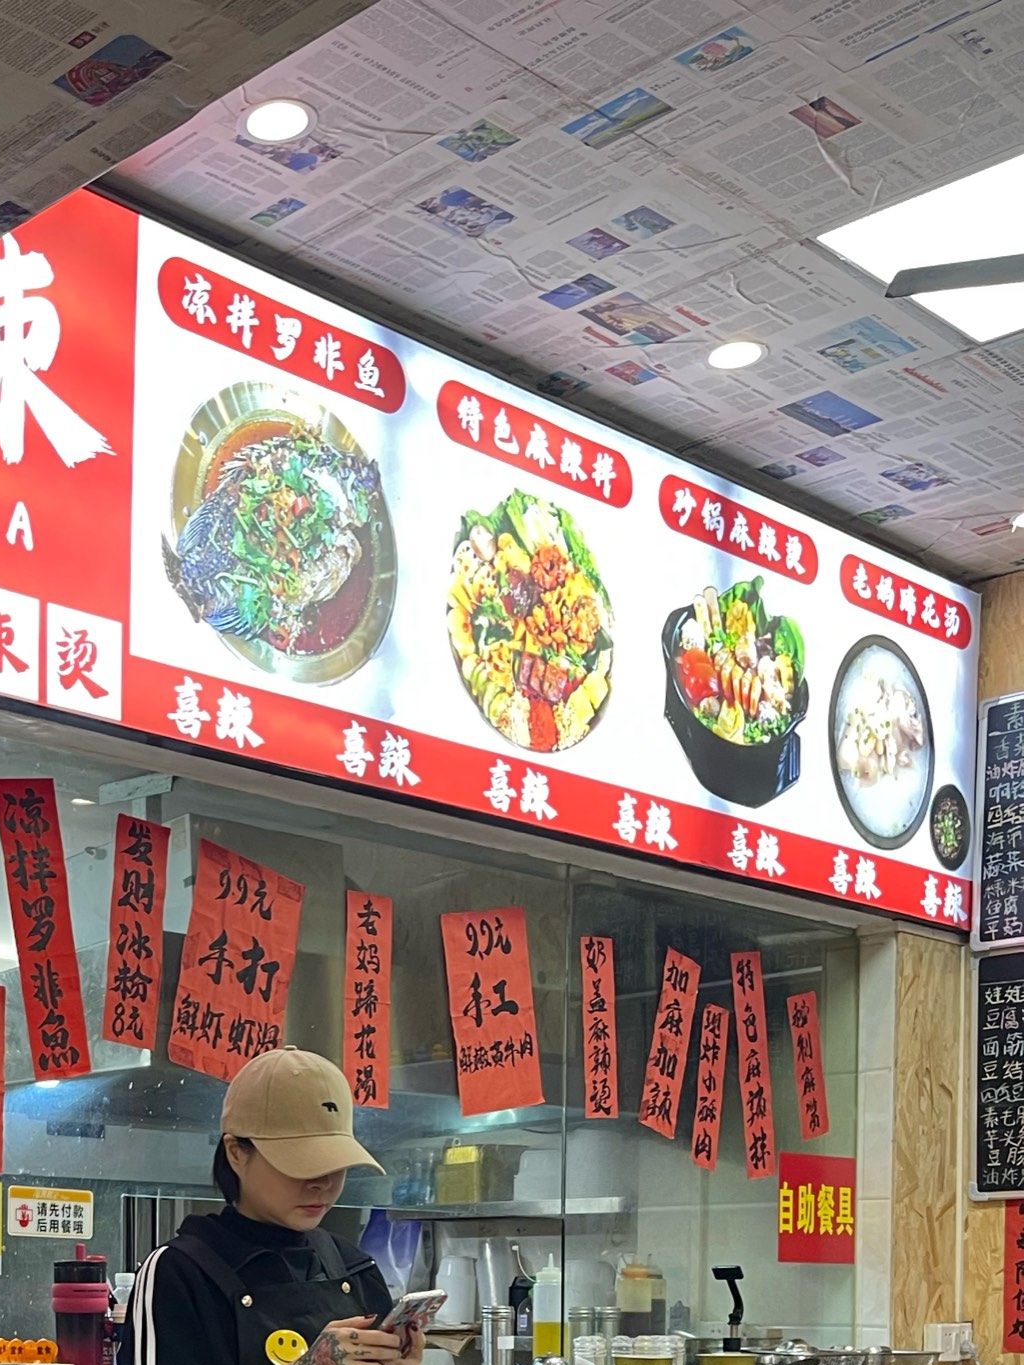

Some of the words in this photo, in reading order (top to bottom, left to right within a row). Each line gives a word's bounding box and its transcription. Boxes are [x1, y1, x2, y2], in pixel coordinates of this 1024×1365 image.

[182, 273, 385, 398] 凉拌罗非鱼
[457, 395, 617, 498] 特色麻辣拌
[672, 487, 807, 576] 砂锅麻辣烫
[167, 675, 265, 749] 喜辣
[336, 719, 421, 786] 喜辣
[483, 758, 558, 821] 喜辣
[612, 792, 679, 851] 喜辣
[727, 823, 785, 878] 喜辣
[828, 849, 882, 900] 喜辣
[920, 874, 968, 924] 喜辣
[198, 929, 280, 1002] 手打
[985, 986, 1024, 1005] 娃娃
[36, 1219, 84, 1235] 后用餐哦
[37, 1202, 84, 1219] 请先付款
[779, 1182, 854, 1236] 自助餐具
